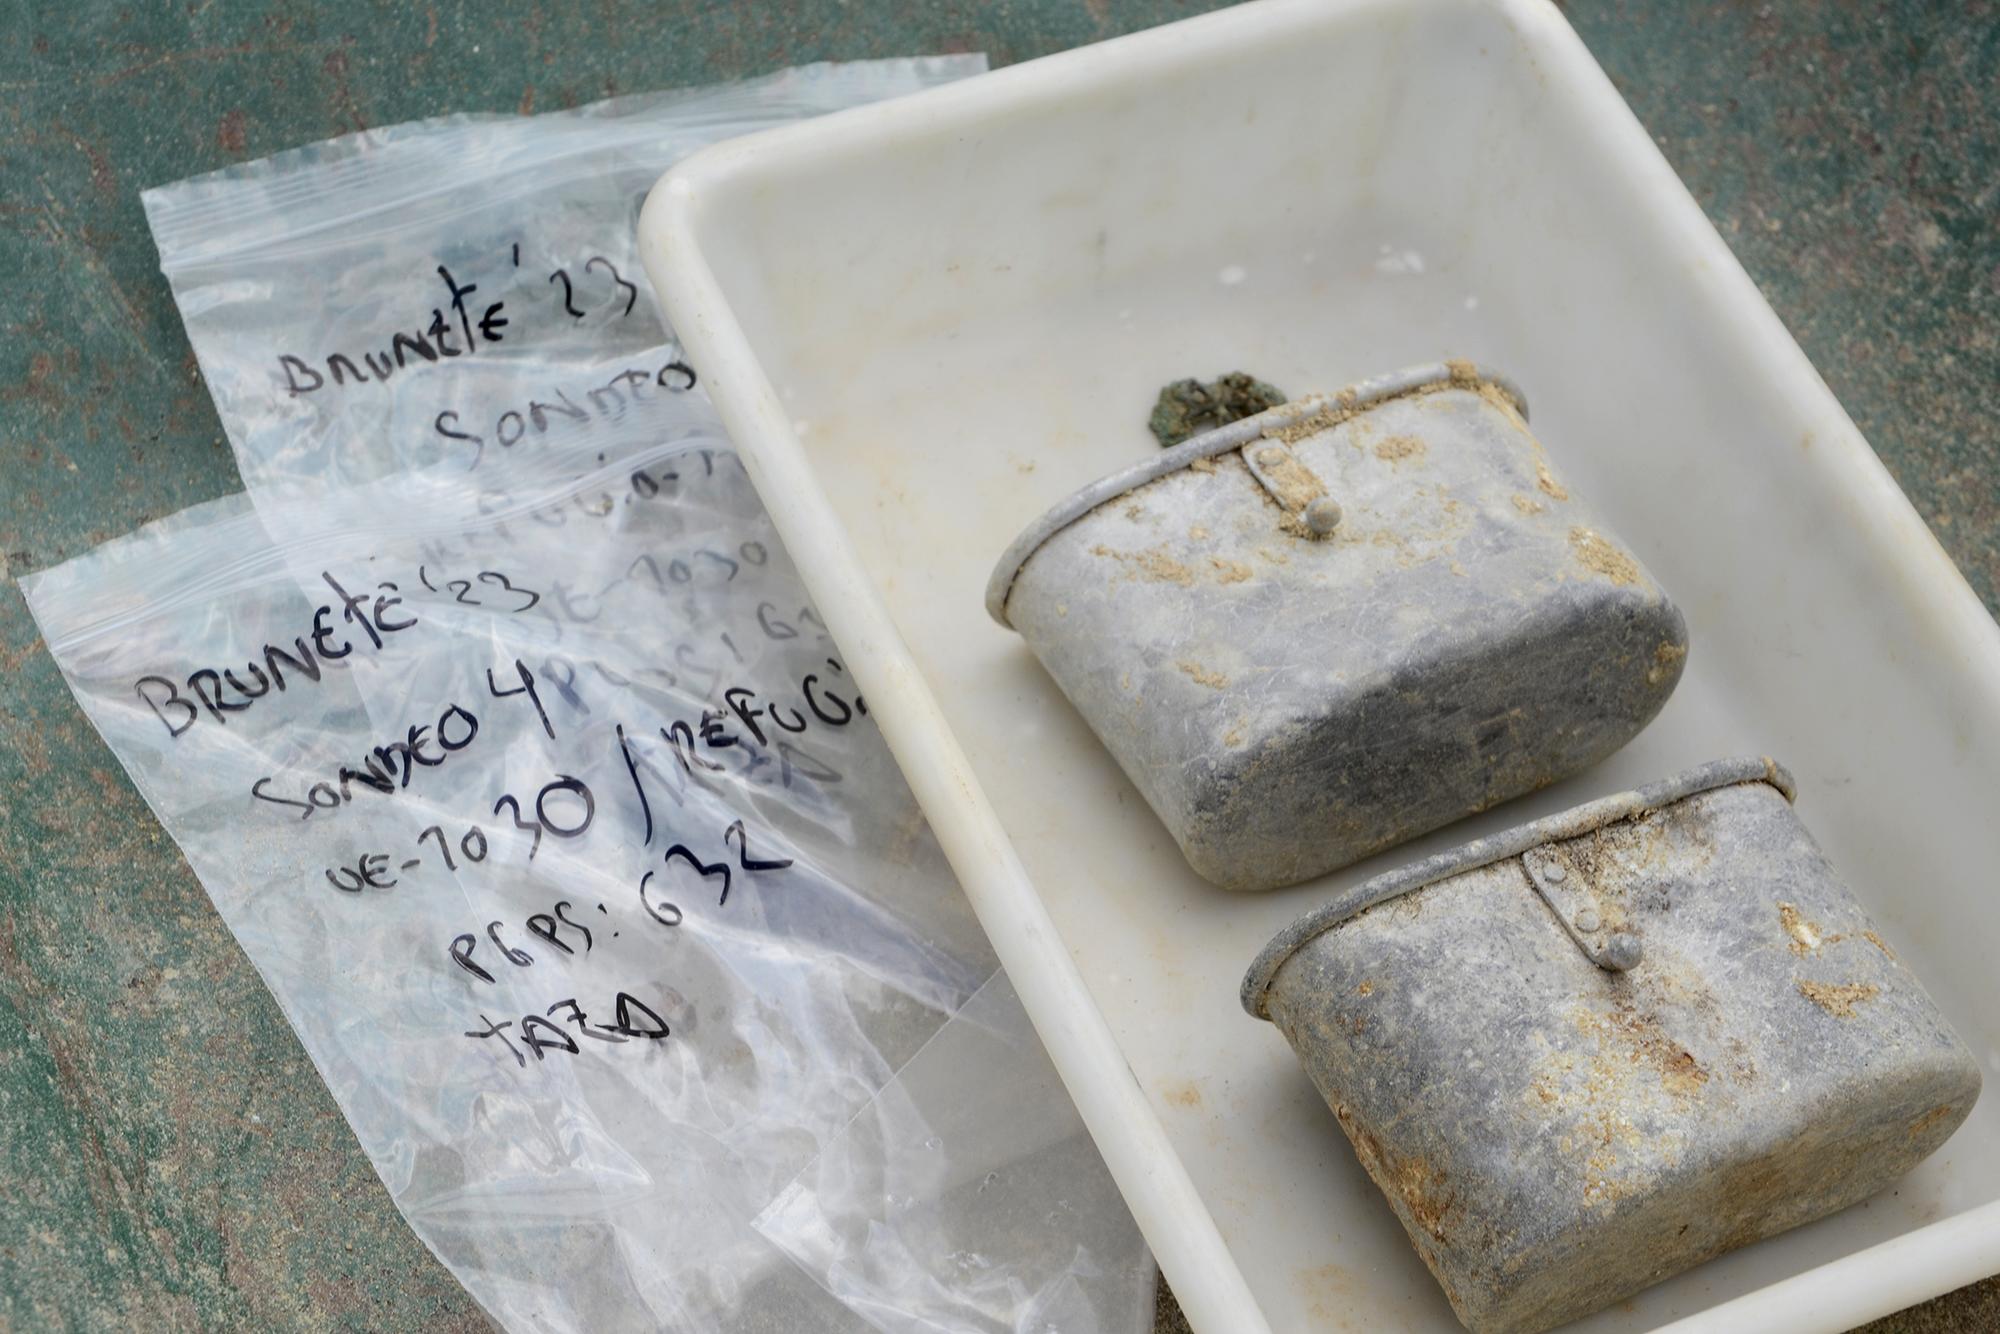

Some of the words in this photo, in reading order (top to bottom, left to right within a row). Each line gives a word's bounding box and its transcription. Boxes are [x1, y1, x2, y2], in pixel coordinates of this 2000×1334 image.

[251, 703, 479, 820] SONDEO
[486, 658, 556, 740] 4
[325, 774, 595, 893] UE-1030
[639, 819, 795, 927] 632
[464, 992, 670, 1068] TAZA
